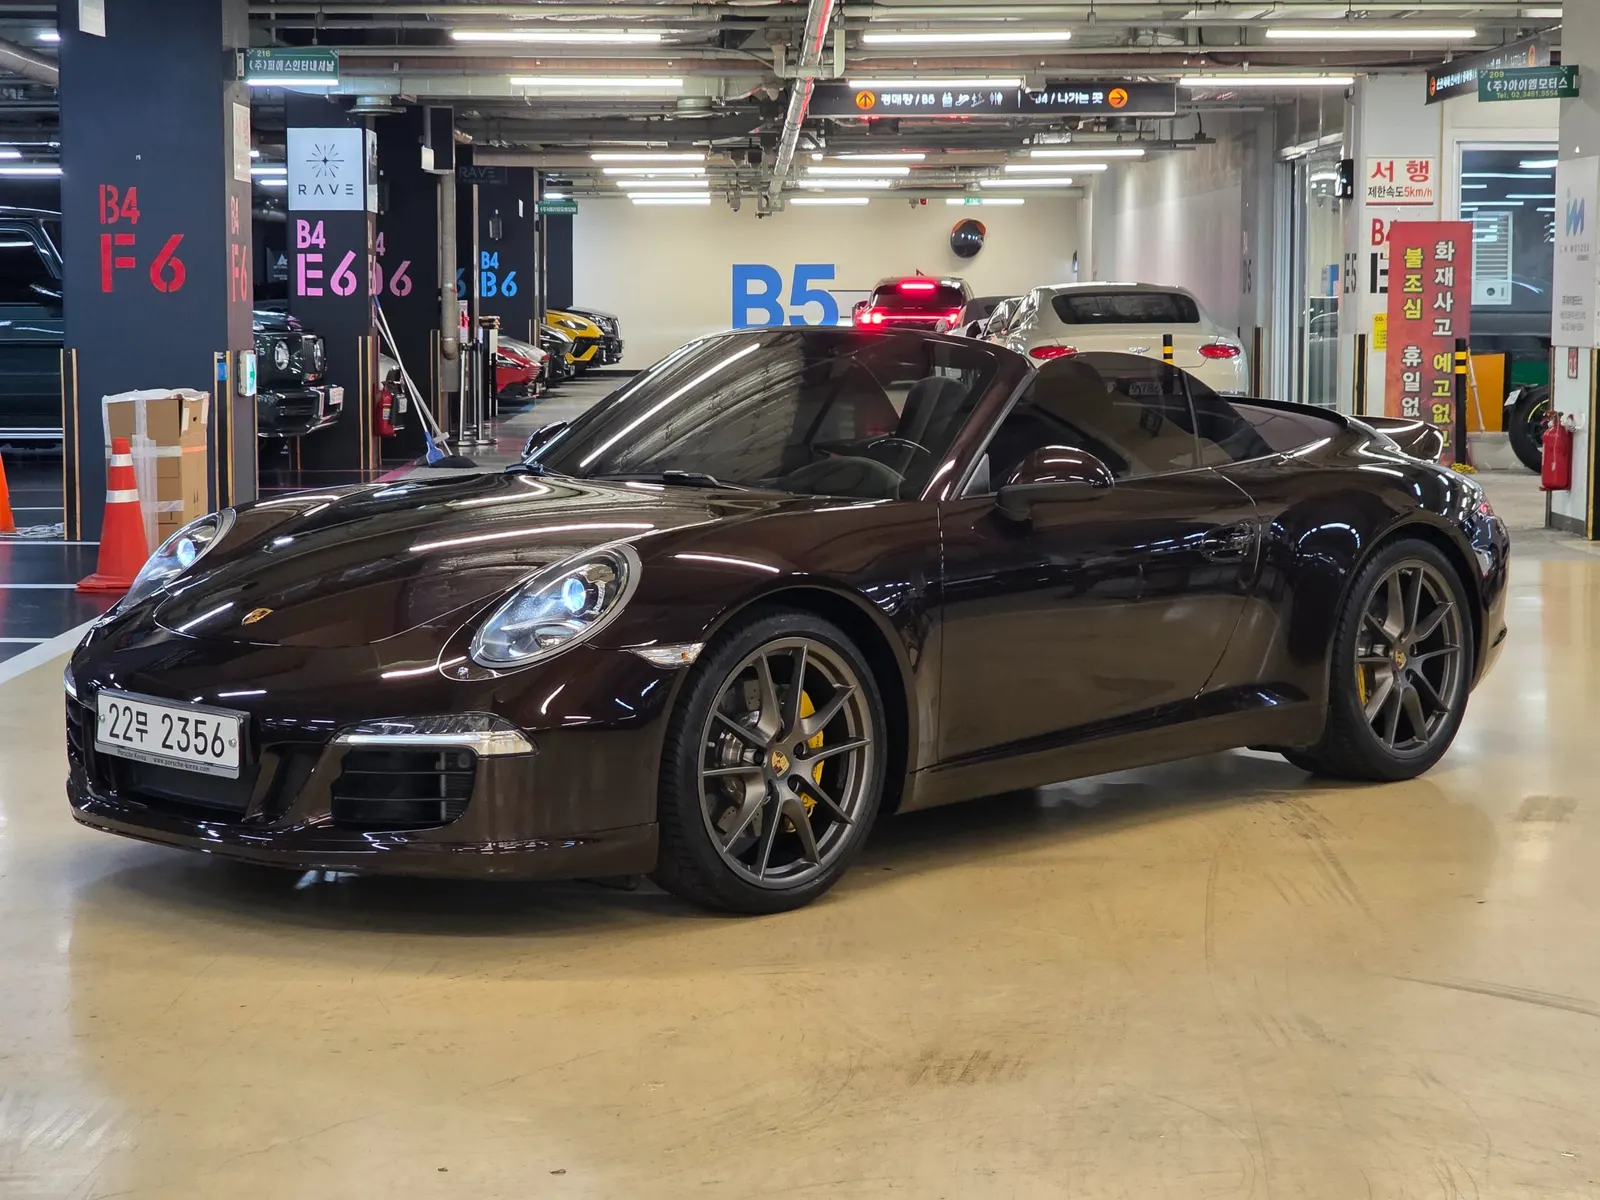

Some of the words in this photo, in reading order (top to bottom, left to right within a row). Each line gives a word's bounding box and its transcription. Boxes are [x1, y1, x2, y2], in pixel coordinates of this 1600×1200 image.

[249, 60, 335, 71] (주)피에스인터내셔날
[1057, 92, 1090, 104] 나가는
[1487, 78, 1568, 92] (주)아이엠모터스
[99, 184, 140, 225] B4
[298, 184, 354, 196] RAVE
[297, 219, 326, 249] B4
[376, 231, 386, 256] 4
[481, 250, 499, 269] B4
[1370, 253, 1389, 293] E
[732, 264, 839, 329] B5
[1403, 248, 1424, 320] 불조심
[1432, 241, 1455, 336] 화재사고
[109, 703, 148, 742] 22무
[161, 713, 225, 758] 2356
